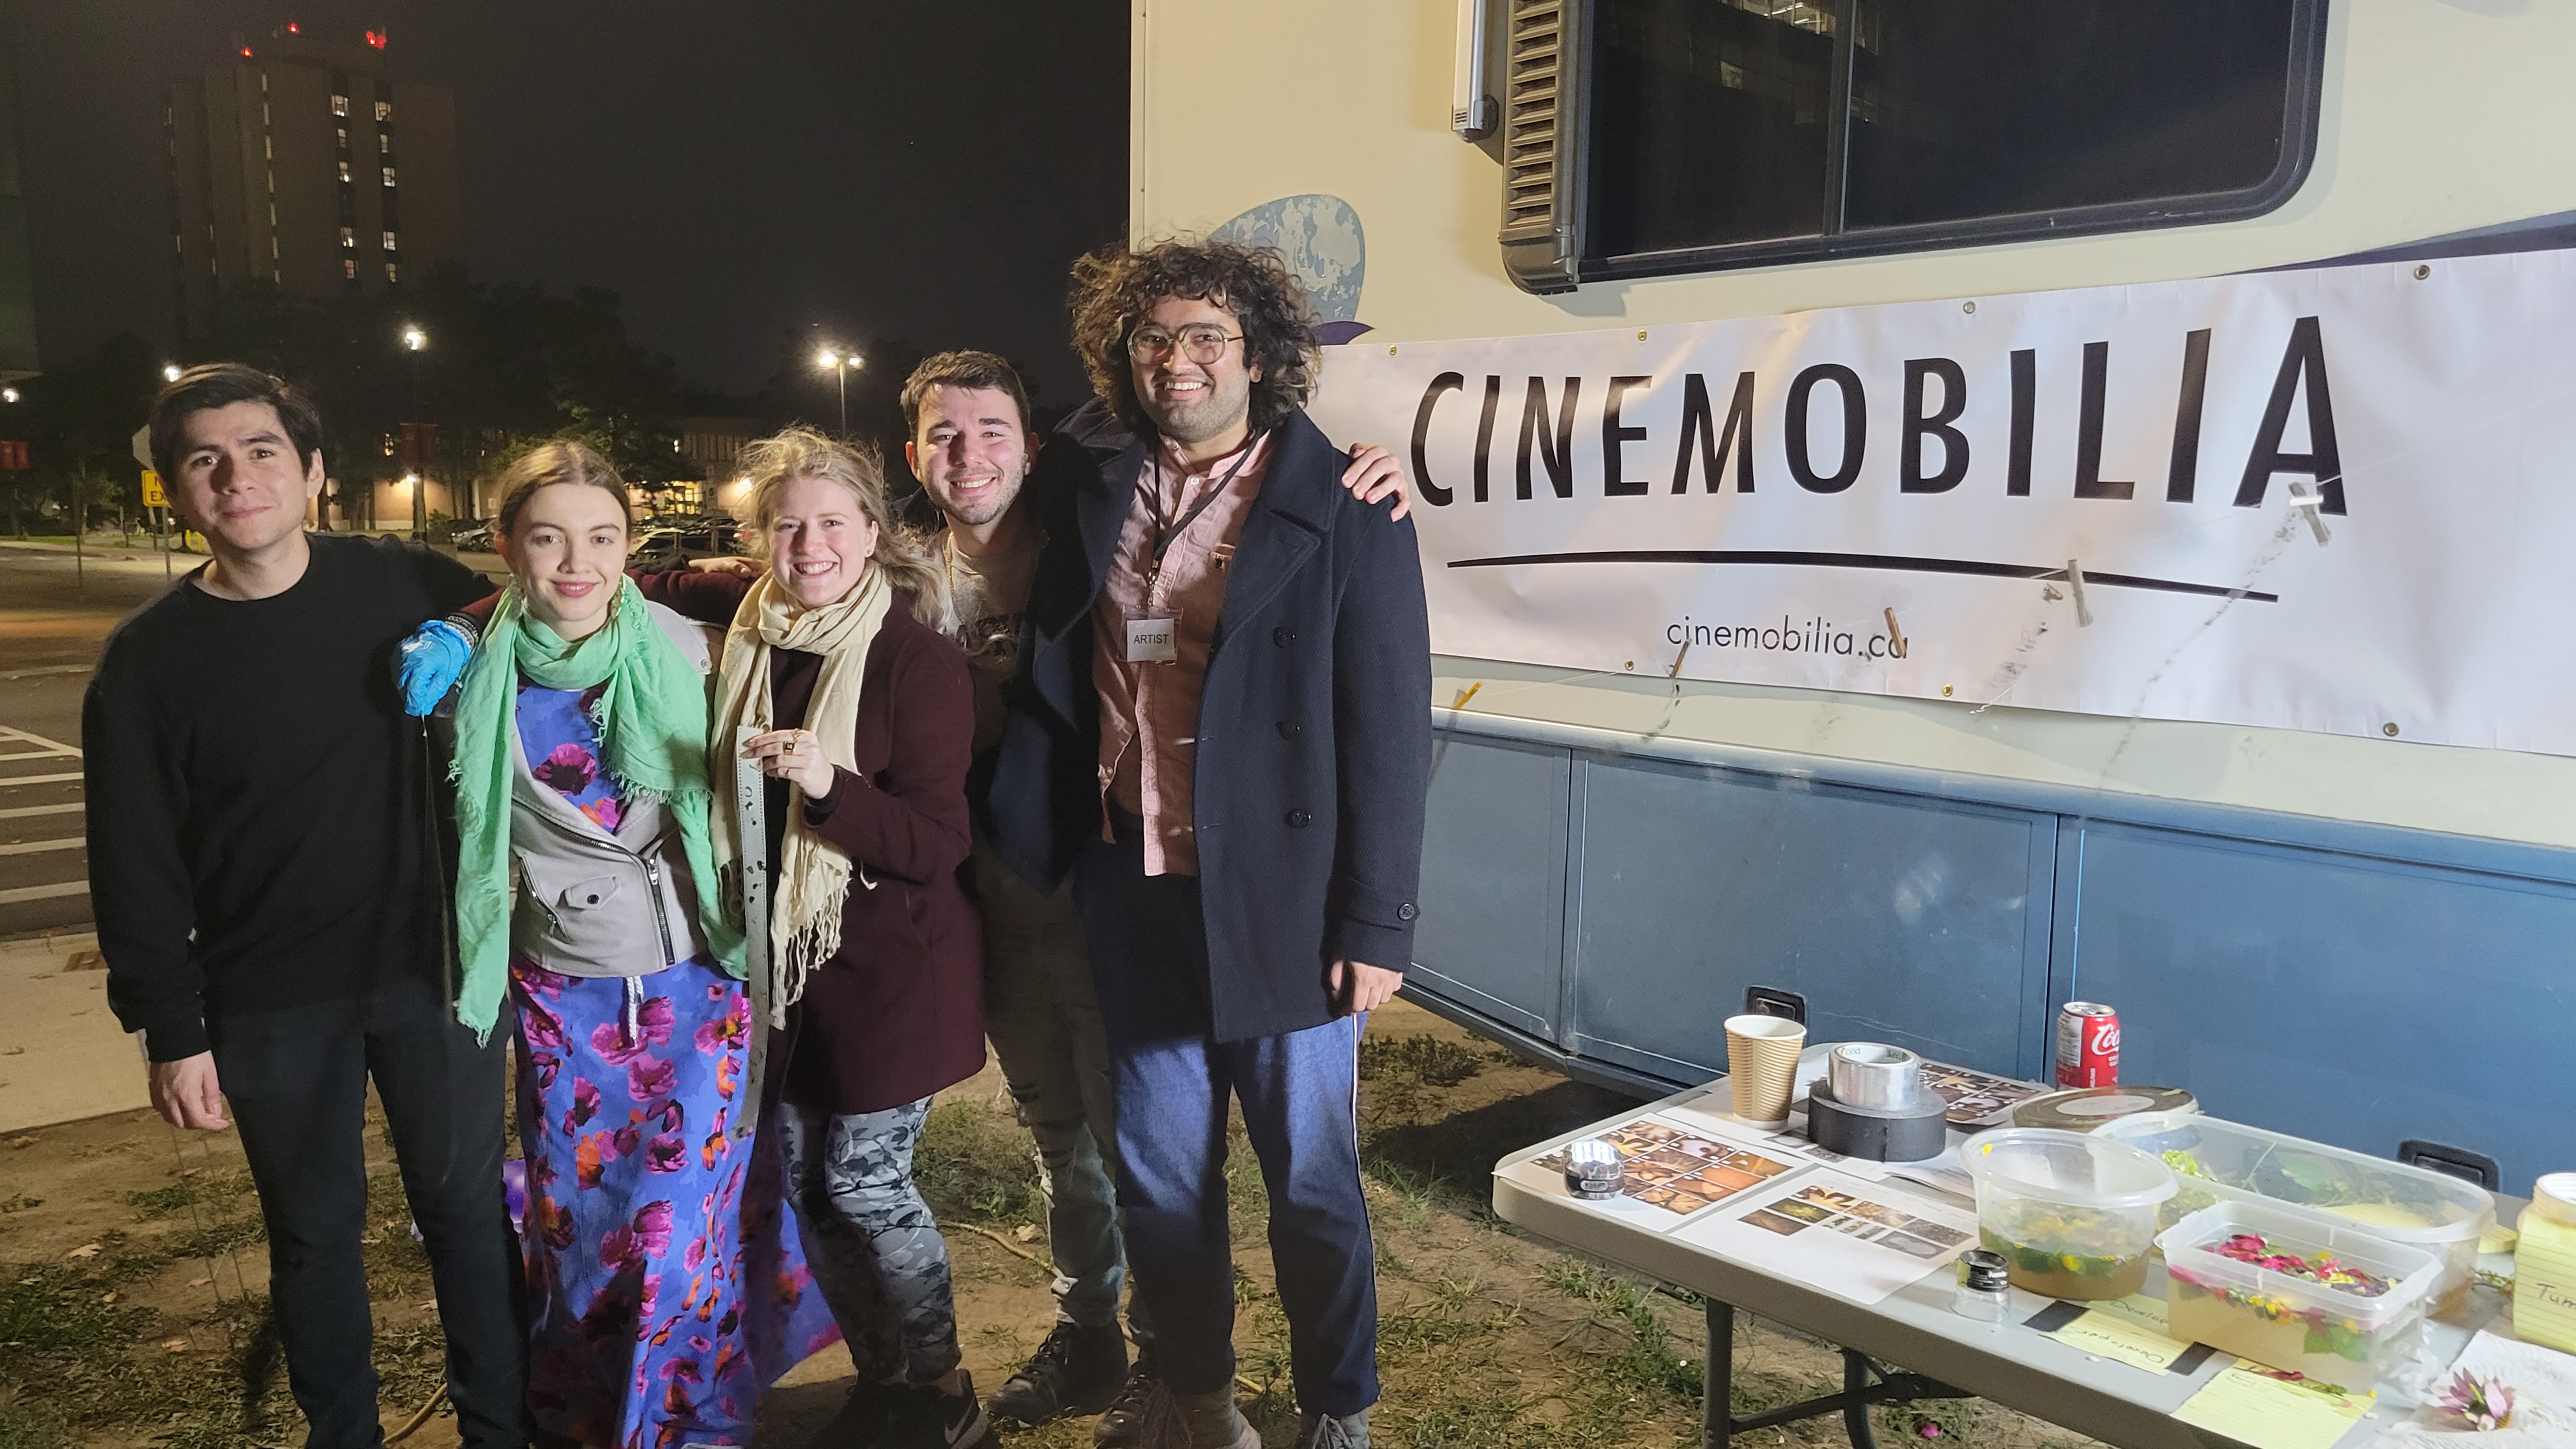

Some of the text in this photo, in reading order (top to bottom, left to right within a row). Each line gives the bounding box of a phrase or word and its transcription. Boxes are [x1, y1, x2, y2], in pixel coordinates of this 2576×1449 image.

[1410, 316, 2348, 517] CINEMOBILIA
[1133, 634, 1169, 644] ARTIST
[1667, 615, 1908, 659] cinemobilia.ca
